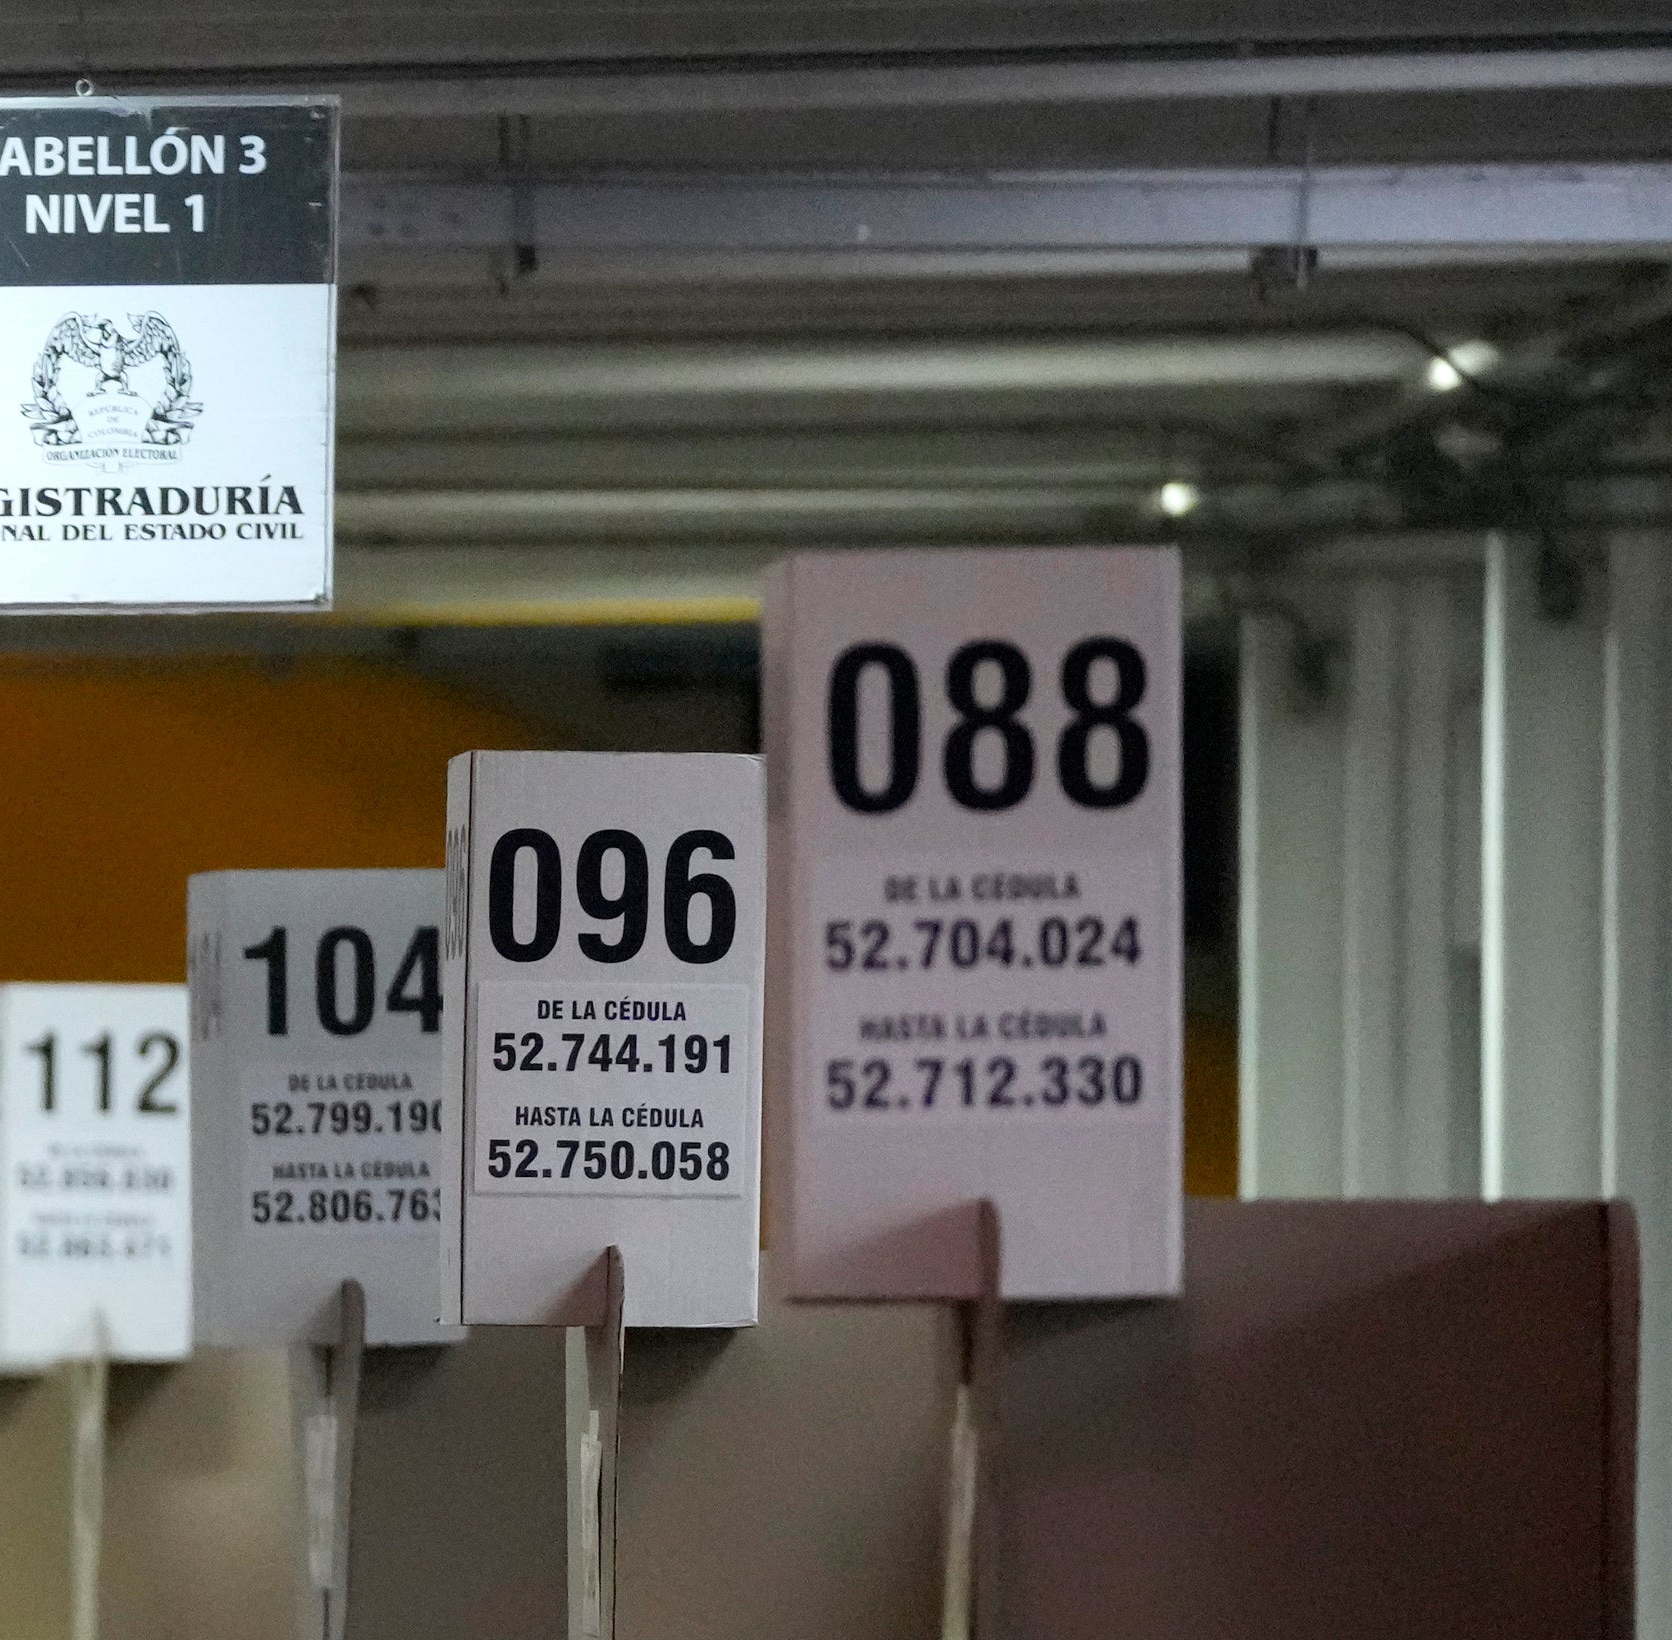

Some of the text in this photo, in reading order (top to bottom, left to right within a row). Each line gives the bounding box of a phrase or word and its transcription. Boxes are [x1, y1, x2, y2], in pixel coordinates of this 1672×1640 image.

[239, 135, 267, 174] 3
[26, 194, 204, 233] NIVEL 1
[62, 523, 113, 541] DEL
[125, 523, 227, 541] ESTADO
[237, 522, 304, 540] CIVIL
[827, 636, 1150, 815] 088
[489, 828, 737, 964] 096
[928, 876, 962, 901] LA
[825, 915, 1142, 970] 52.704.024
[243, 925, 443, 1036] 104
[537, 995, 687, 1022] DE LA CÉDULA
[26, 1030, 180, 1113] 112
[491, 1031, 731, 1073] 52.744.191
[287, 1074, 309, 1092] DE
[316, 1074, 337, 1091] LA
[826, 1055, 1143, 1111] 52.712.330
[515, 1101, 704, 1129] HASTA LA CÉDULA
[334, 1162, 355, 1179] LA
[487, 1139, 731, 1181] 52.750.058
